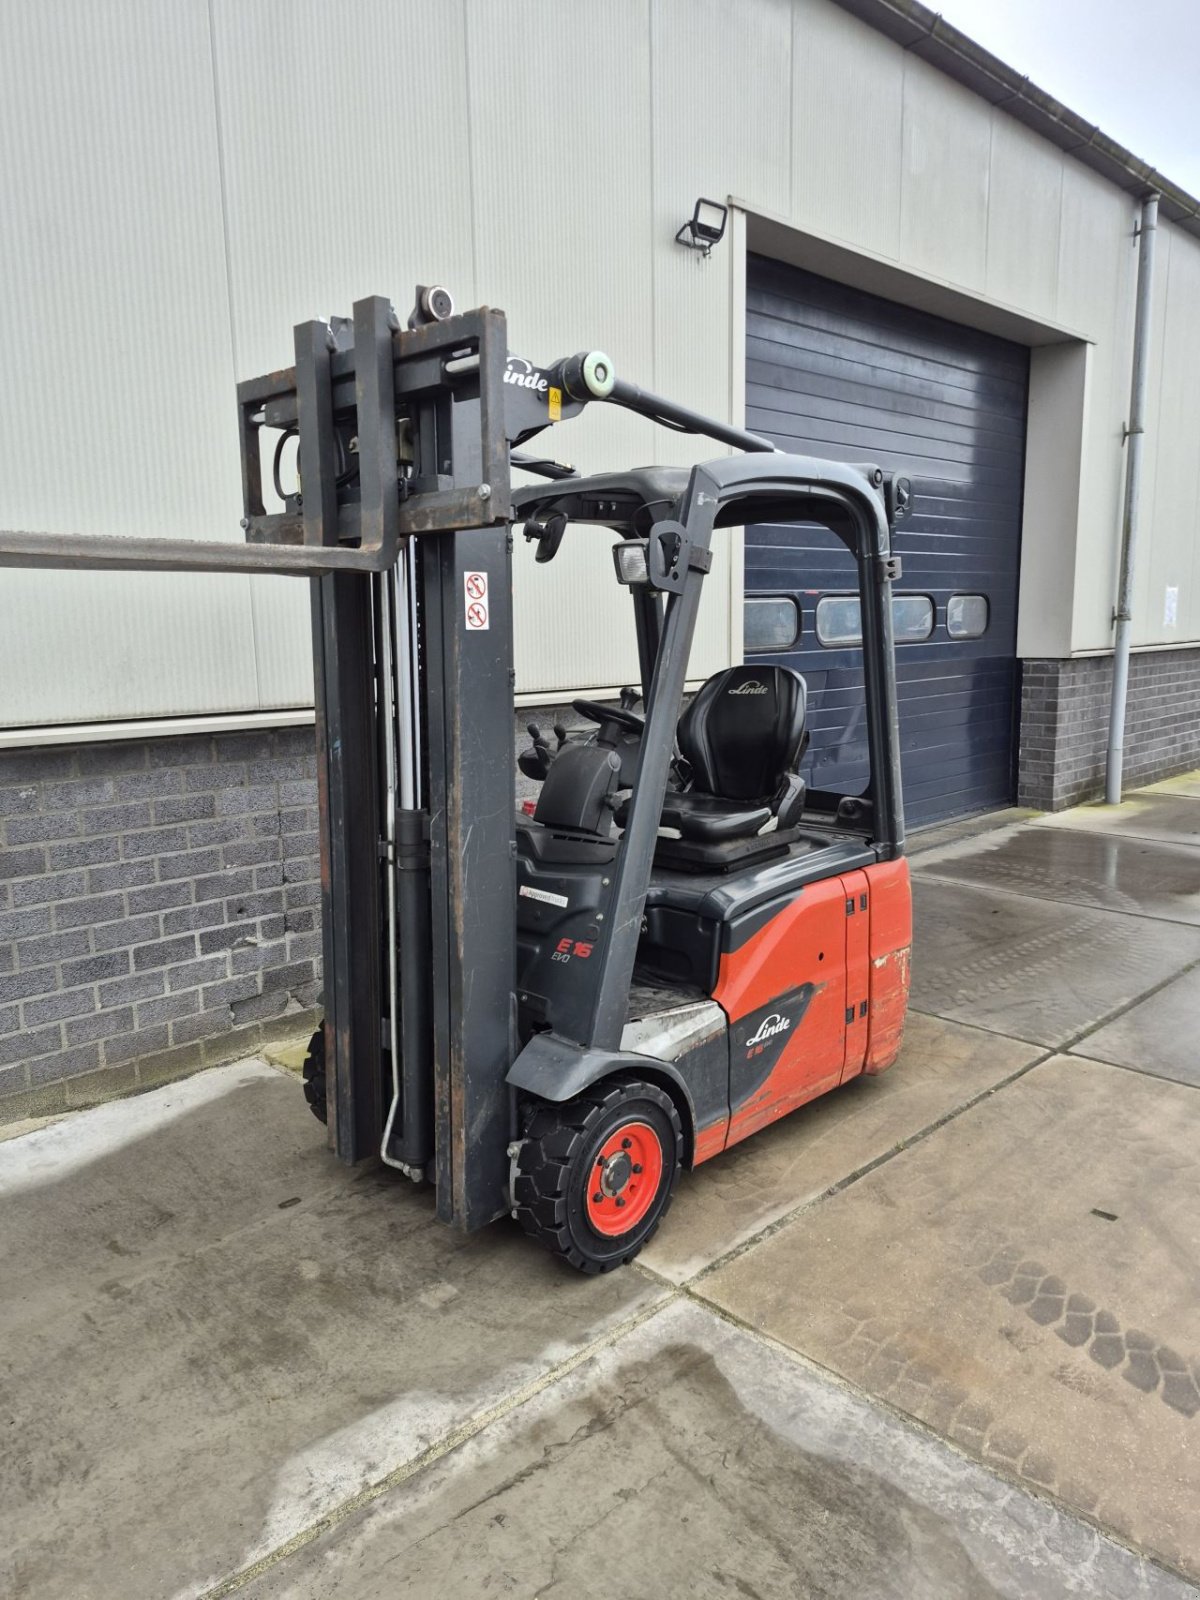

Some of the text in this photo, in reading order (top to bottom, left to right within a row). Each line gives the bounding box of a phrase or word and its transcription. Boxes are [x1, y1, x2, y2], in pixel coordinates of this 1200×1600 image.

[728, 680, 768, 695] Linde
[551, 952, 570, 963] EVO
[746, 1014, 790, 1046] Linde
